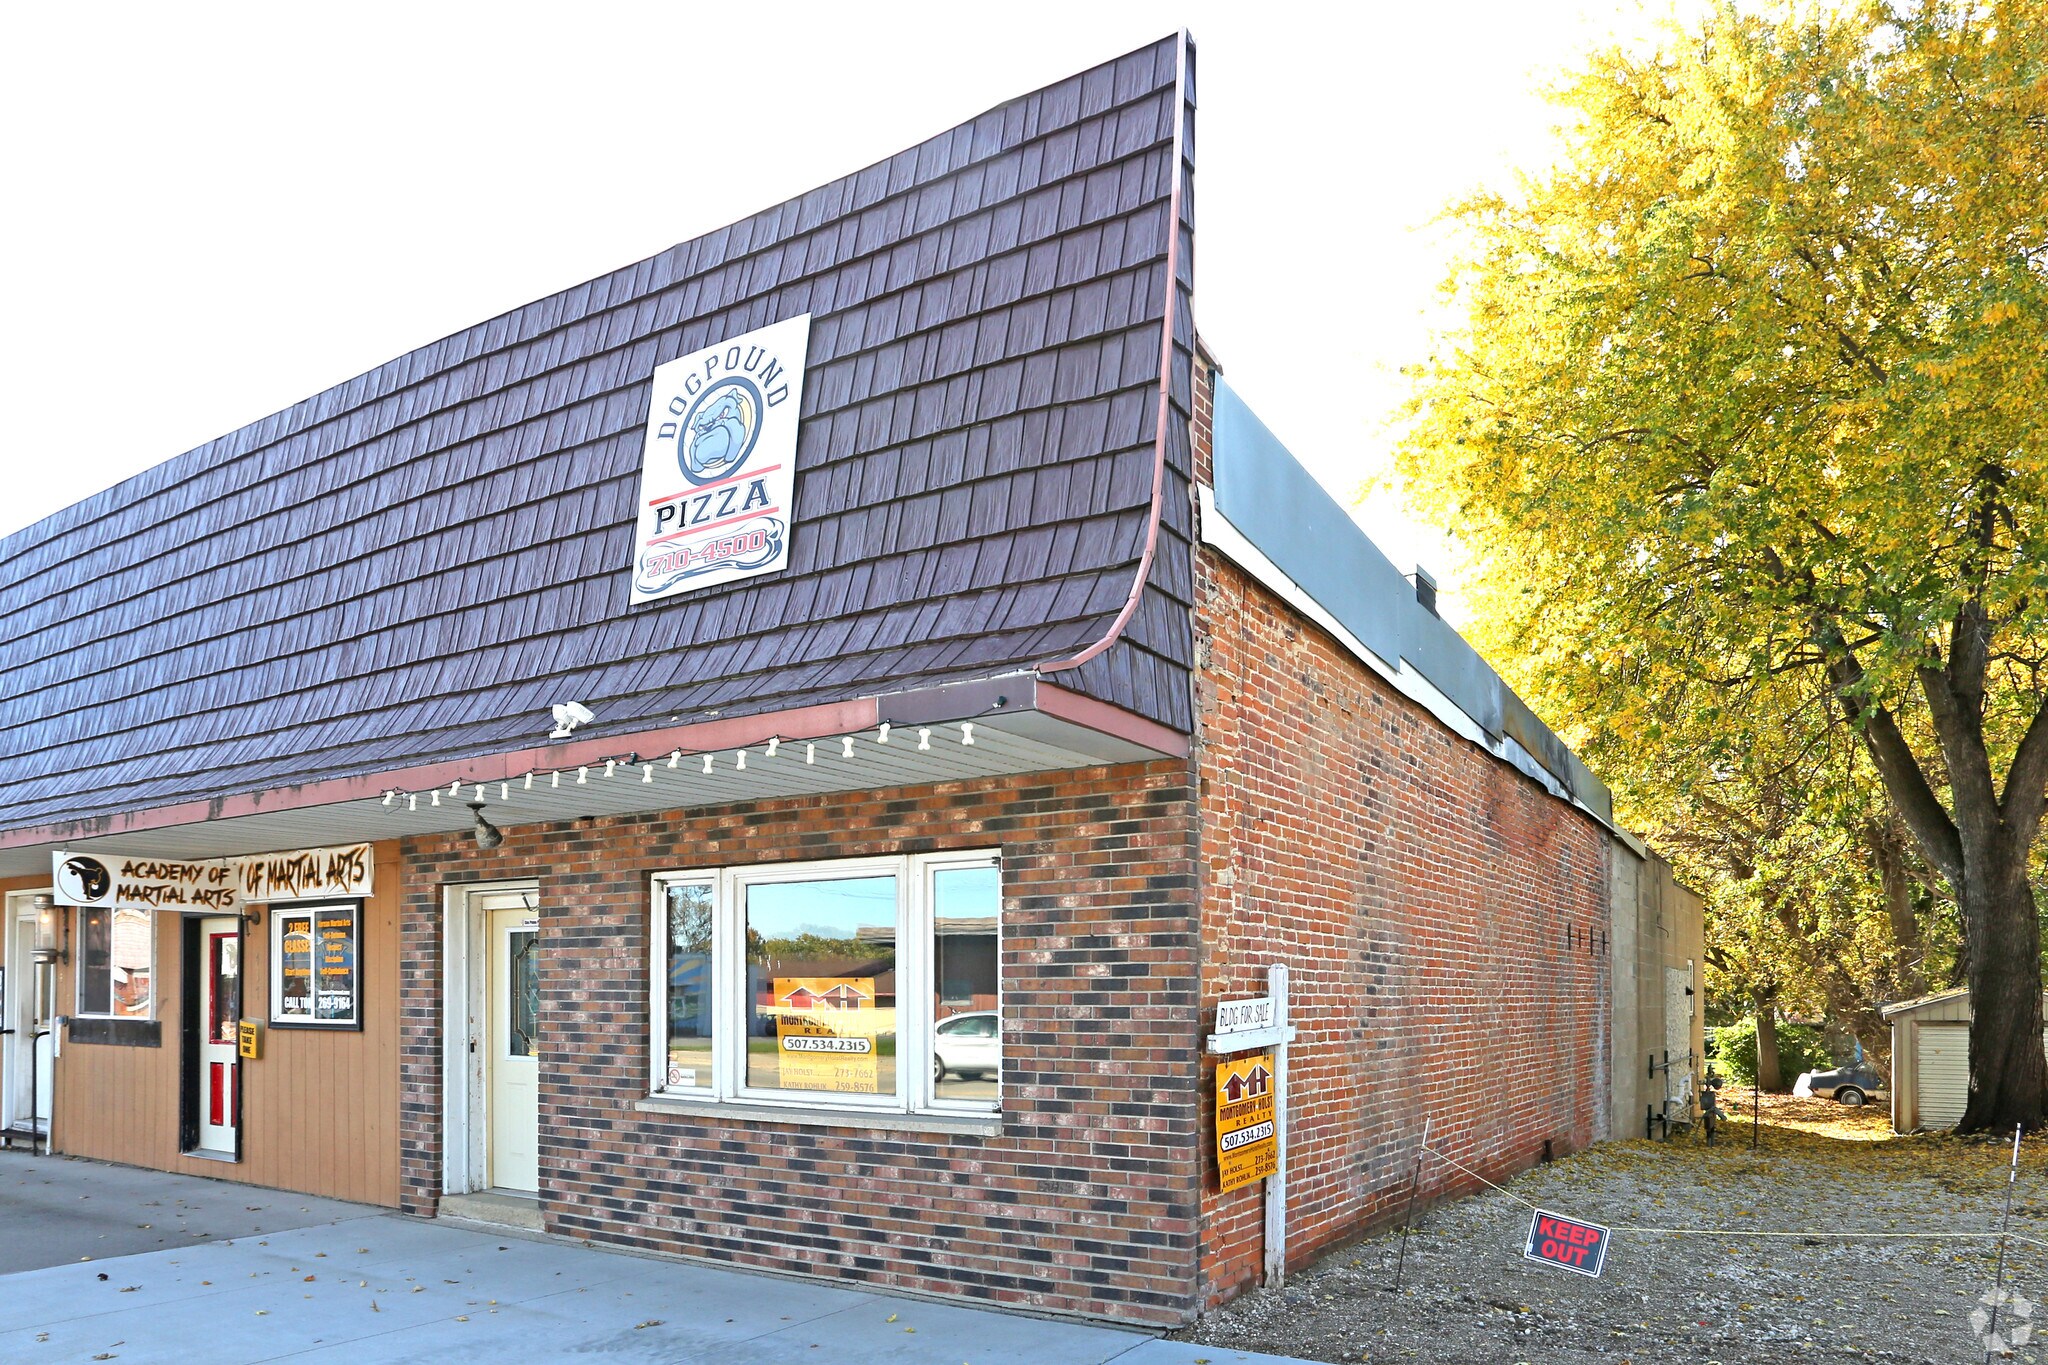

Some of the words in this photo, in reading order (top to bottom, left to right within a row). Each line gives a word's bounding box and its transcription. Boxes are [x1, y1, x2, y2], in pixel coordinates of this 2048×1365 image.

[657, 345, 789, 440] DOGPOUND
[654, 478, 770, 535] PIZZA
[646, 529, 768, 578] 710-4500
[120, 859, 203, 884] ACADEMY
[207, 867, 231, 884] OF
[246, 861, 264, 899] OF
[267, 853, 322, 898] MARTIAL
[326, 846, 369, 896] ARTS
[115, 883, 188, 907] MARTIAL
[190, 887, 235, 910] ARTS
[284, 996, 299, 1009] CALL
[1219, 1006, 1239, 1027] BLDG
[1240, 1004, 1253, 1025] FOR
[1254, 1002, 1269, 1023] SALE
[787, 1038, 866, 1051] 507.534.2315
[834, 1067, 873, 1079] 273-7662
[1236, 1110, 1272, 1127] REALTY
[1224, 1123, 1272, 1148] 507.534.2315
[1539, 1217, 1599, 1247] KEEP
[1541, 1240, 1588, 1267] OUT
